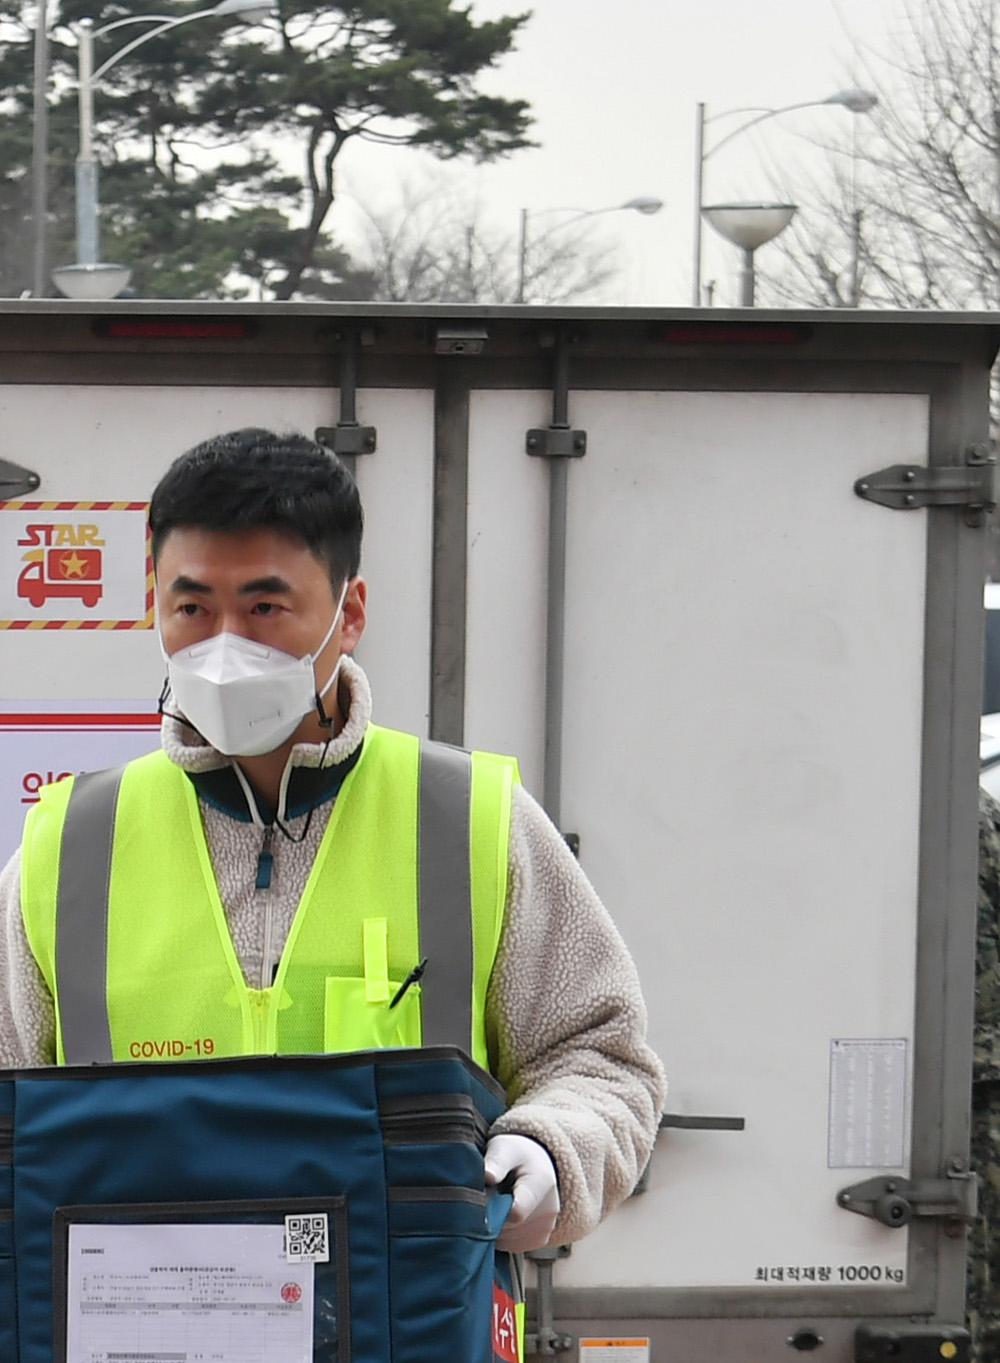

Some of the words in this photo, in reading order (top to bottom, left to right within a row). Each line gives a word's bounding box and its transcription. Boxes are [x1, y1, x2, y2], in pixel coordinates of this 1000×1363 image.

[17, 524, 105, 546] STAR
[129, 1038, 214, 1058] COVID-19
[755, 1266, 832, 1282] 최대적재량
[837, 1265, 882, 1281] 1000
[885, 1266, 904, 1283] kg
